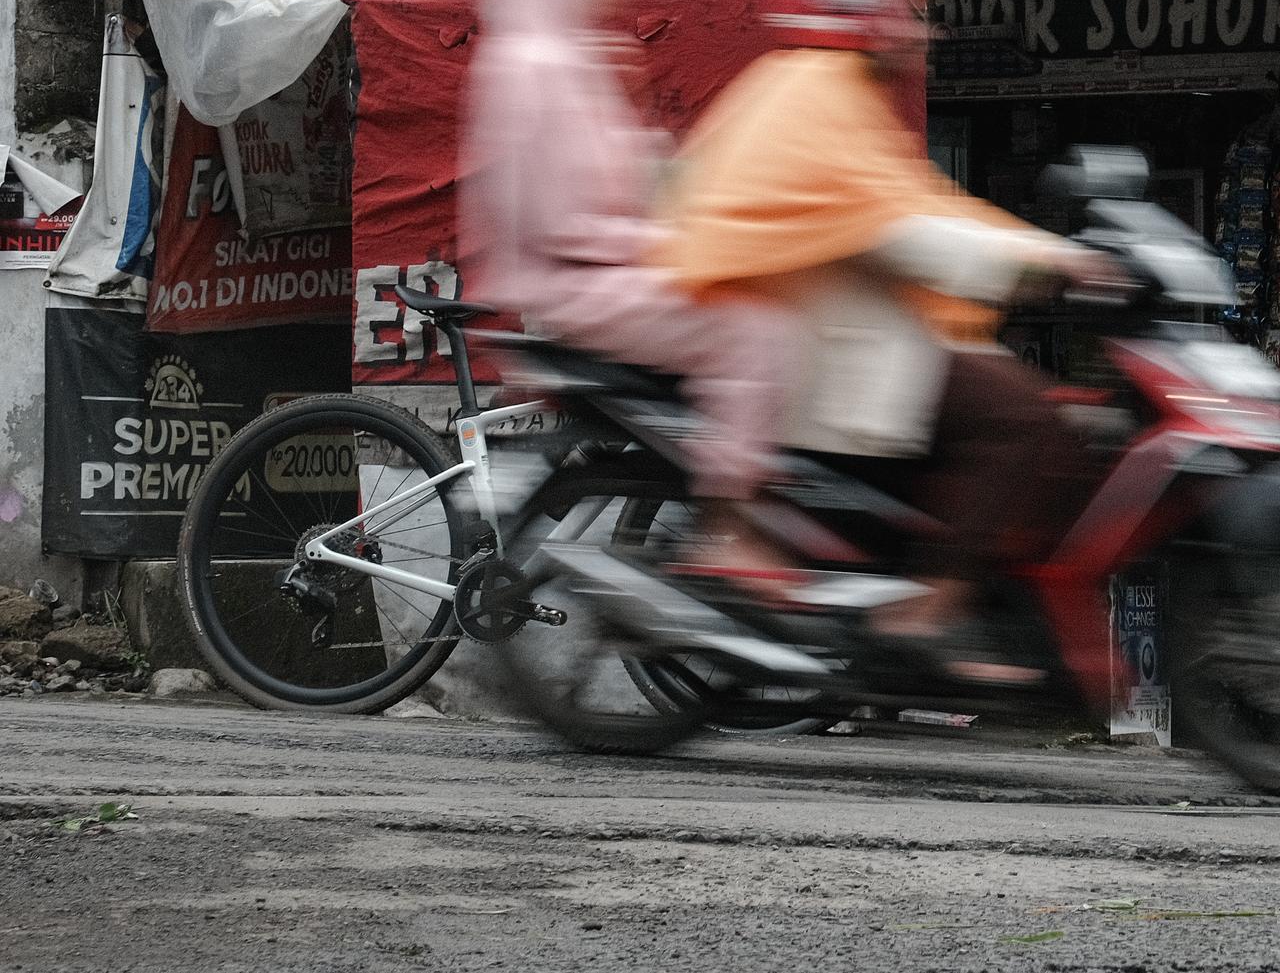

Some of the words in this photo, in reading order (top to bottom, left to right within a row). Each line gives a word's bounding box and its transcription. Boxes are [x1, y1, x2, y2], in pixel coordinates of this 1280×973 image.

[48, 215, 77, 223] 29.00
[214, 236, 283, 267] SIKAT
[286, 234, 330, 259] GIGI
[215, 277, 245, 307] DI
[157, 377, 191, 403] 234
[113, 416, 232, 457] SUPER
[281, 444, 359, 478] 20.000
[80, 461, 251, 502] PREMIM
